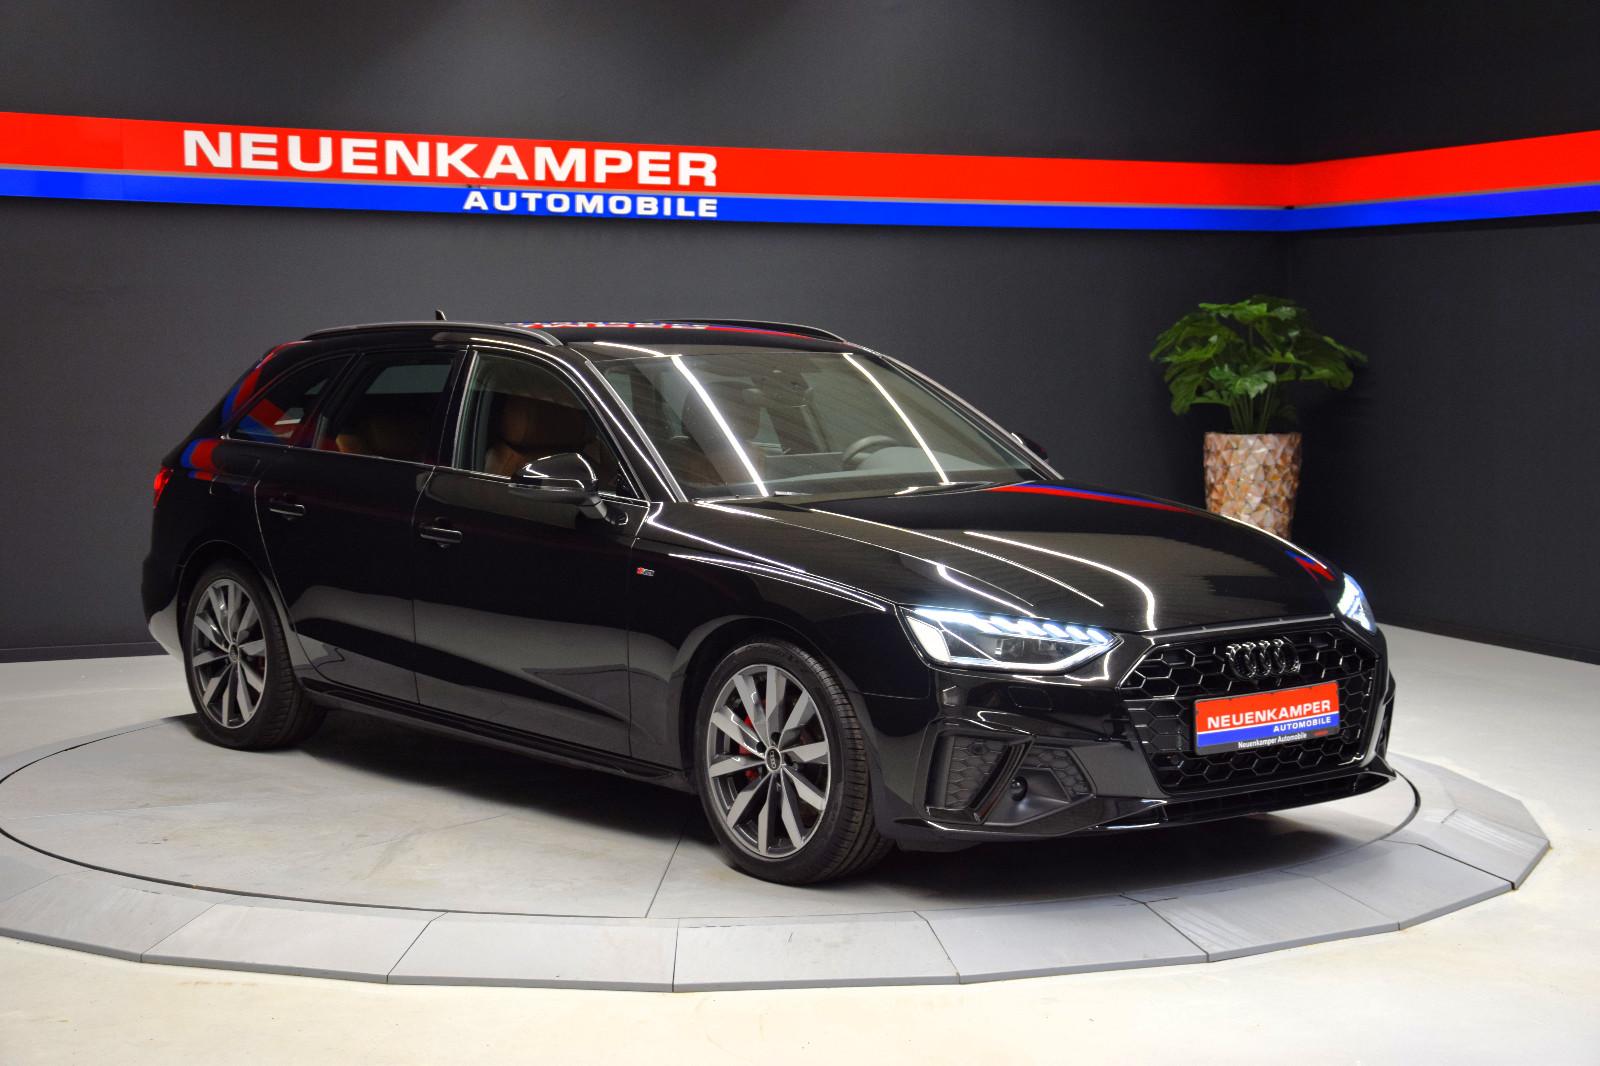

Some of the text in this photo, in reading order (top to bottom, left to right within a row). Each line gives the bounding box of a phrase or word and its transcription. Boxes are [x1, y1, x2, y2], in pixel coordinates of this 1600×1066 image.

[183, 129, 718, 187] NEUENKAMPER
[463, 191, 718, 218] AUTOMOBILE
[1207, 699, 1331, 729] NEUENKAMPER
[1273, 716, 1332, 733] AUTOMOBILE
[1238, 732, 1308, 749] Neuenkamper Automobile
